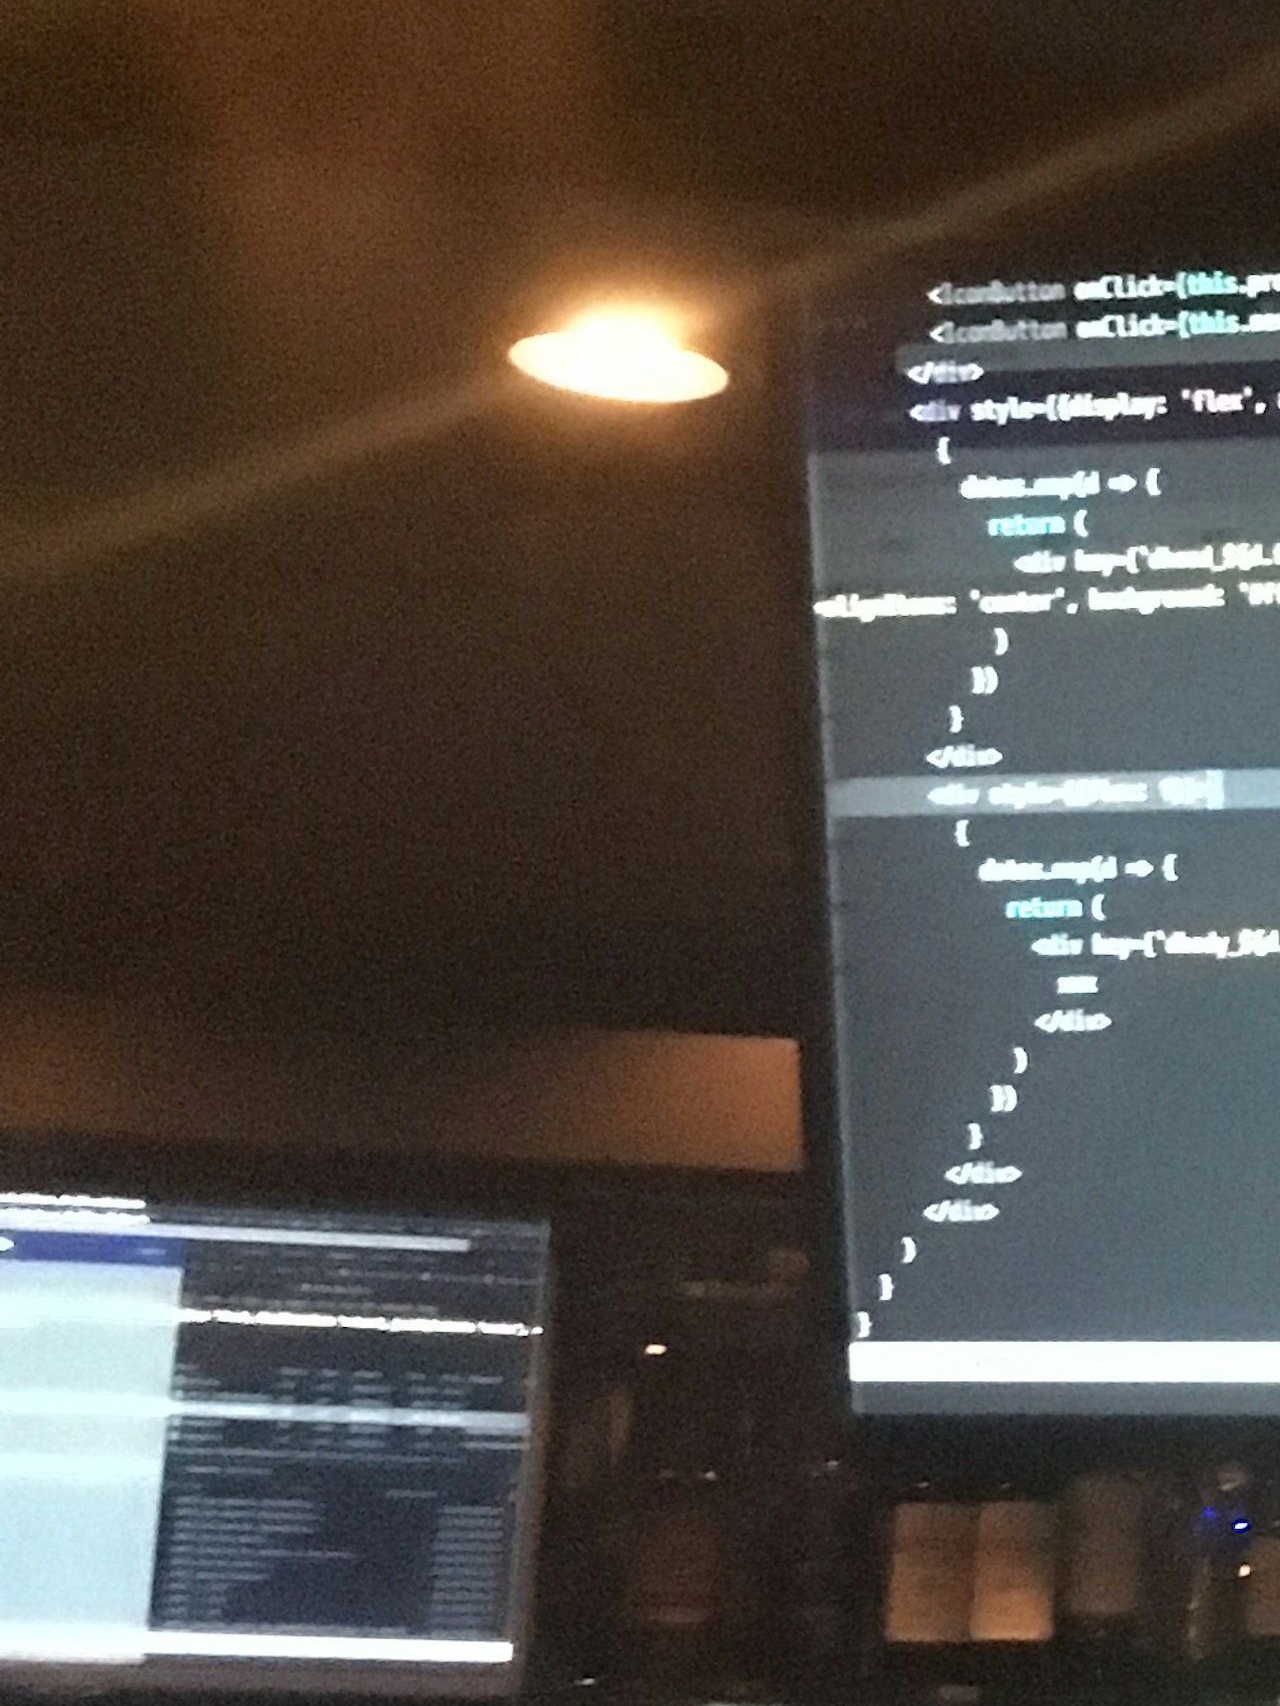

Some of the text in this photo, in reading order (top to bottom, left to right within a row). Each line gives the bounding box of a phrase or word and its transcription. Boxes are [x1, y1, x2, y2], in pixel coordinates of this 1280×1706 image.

[905, 360, 985, 385] </div>
[908, 401, 961, 422] <div
[986, 514, 1067, 537] return
[1013, 550, 1067, 574] <div
[925, 744, 1003, 769] </div>
[928, 784, 979, 805] <div
[1005, 896, 1083, 919] return
[1030, 932, 1084, 957] <div
[1033, 1008, 1113, 1034] </div>
[944, 1161, 1023, 1185] </div>
[922, 1199, 1000, 1223] </div>
